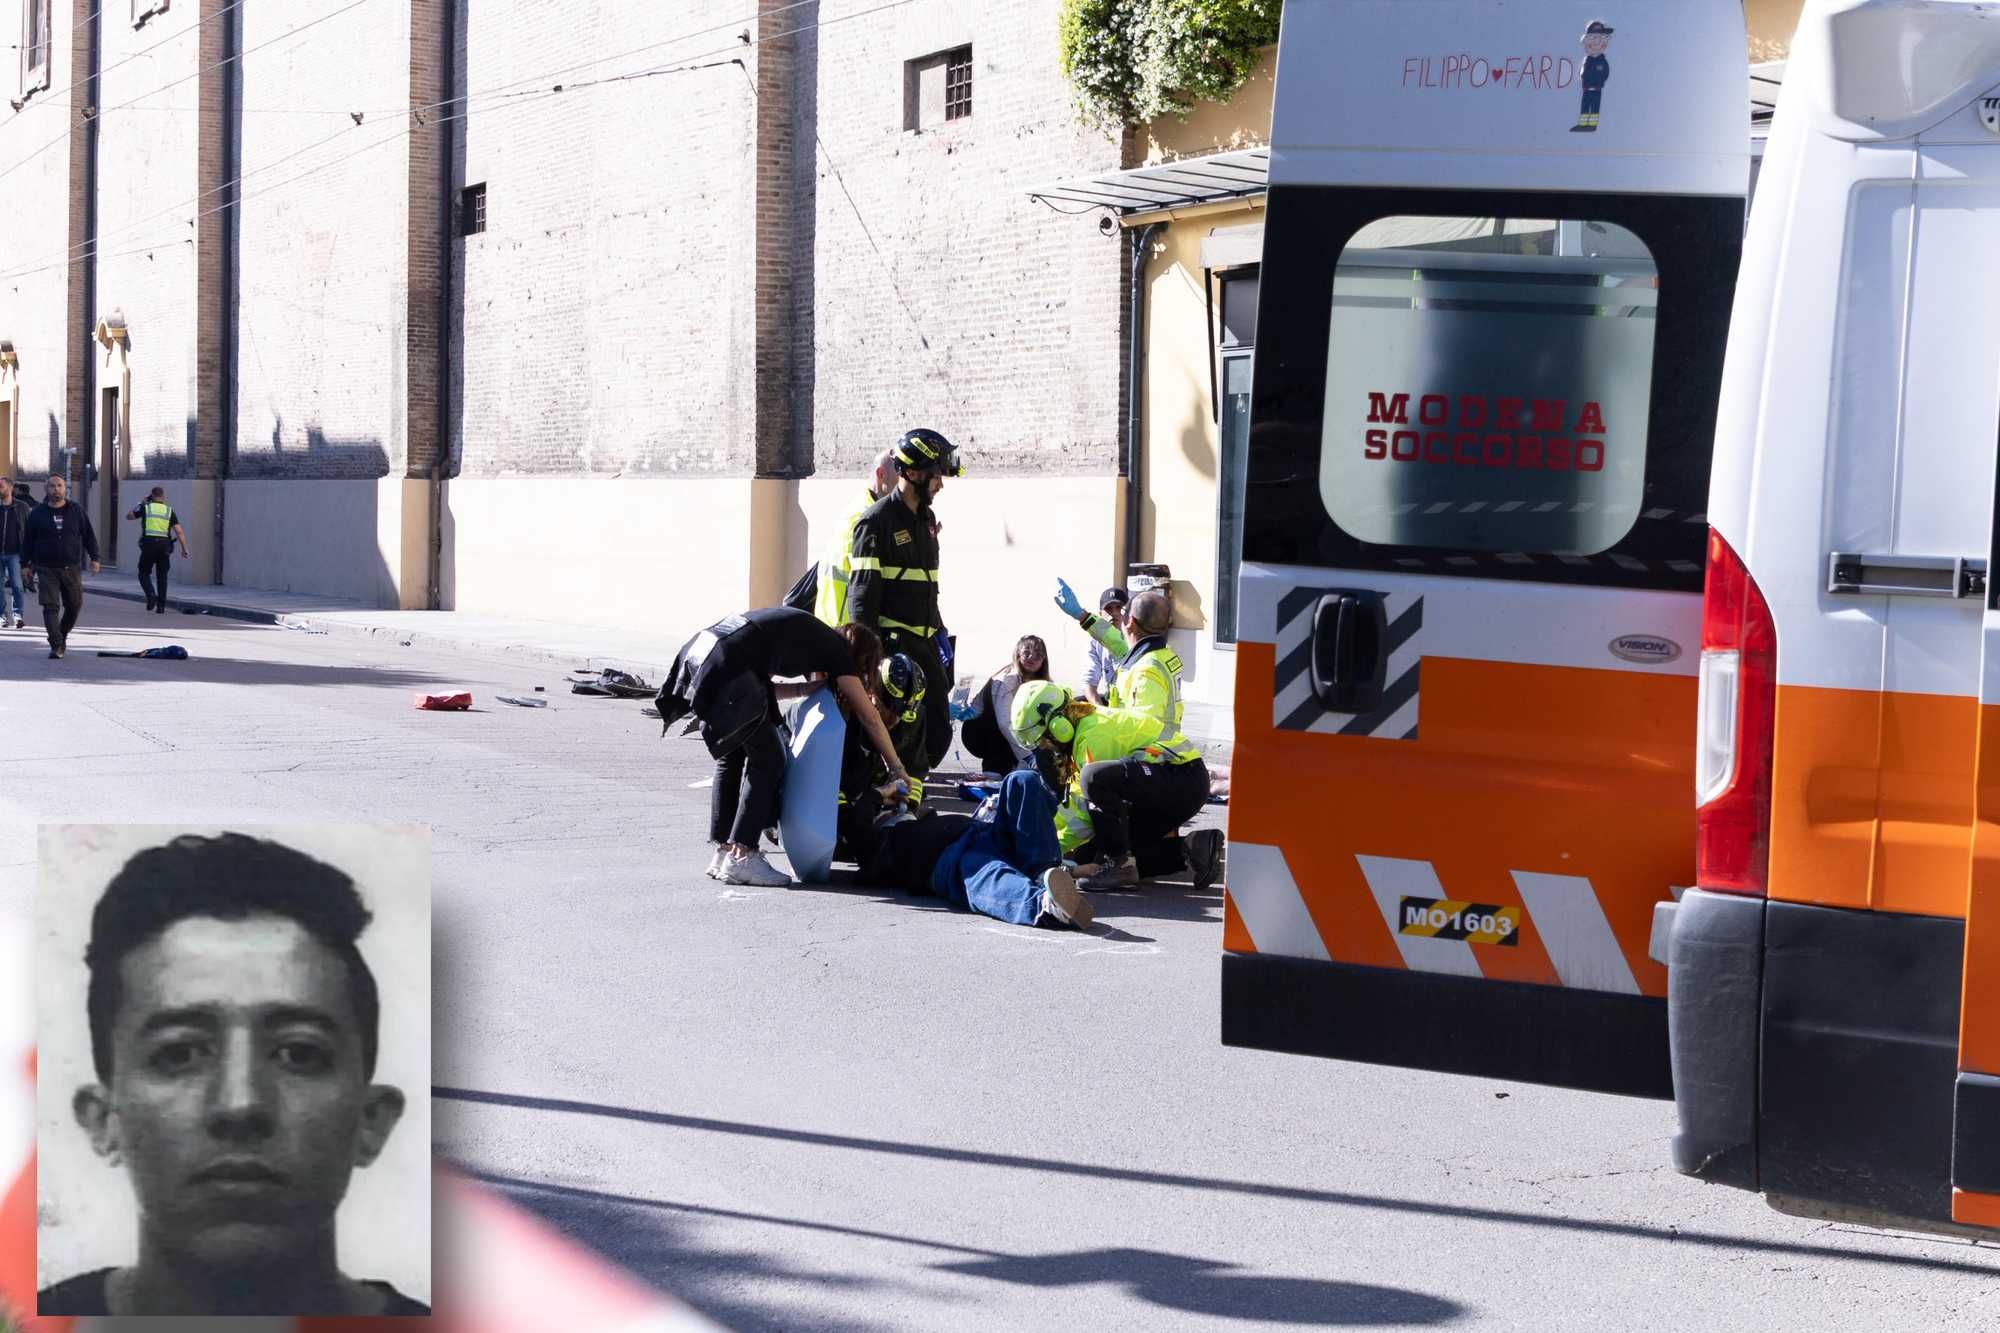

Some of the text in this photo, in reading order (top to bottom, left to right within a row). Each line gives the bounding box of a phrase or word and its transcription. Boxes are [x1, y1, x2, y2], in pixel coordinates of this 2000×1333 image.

[1402, 54, 1574, 89] FILIPPO FARD
[1366, 392, 1606, 434] MODENA
[1364, 429, 1605, 472] SOCCORSO
[1618, 640, 1667, 651] VISION
[1406, 906, 1513, 936] MO1603
